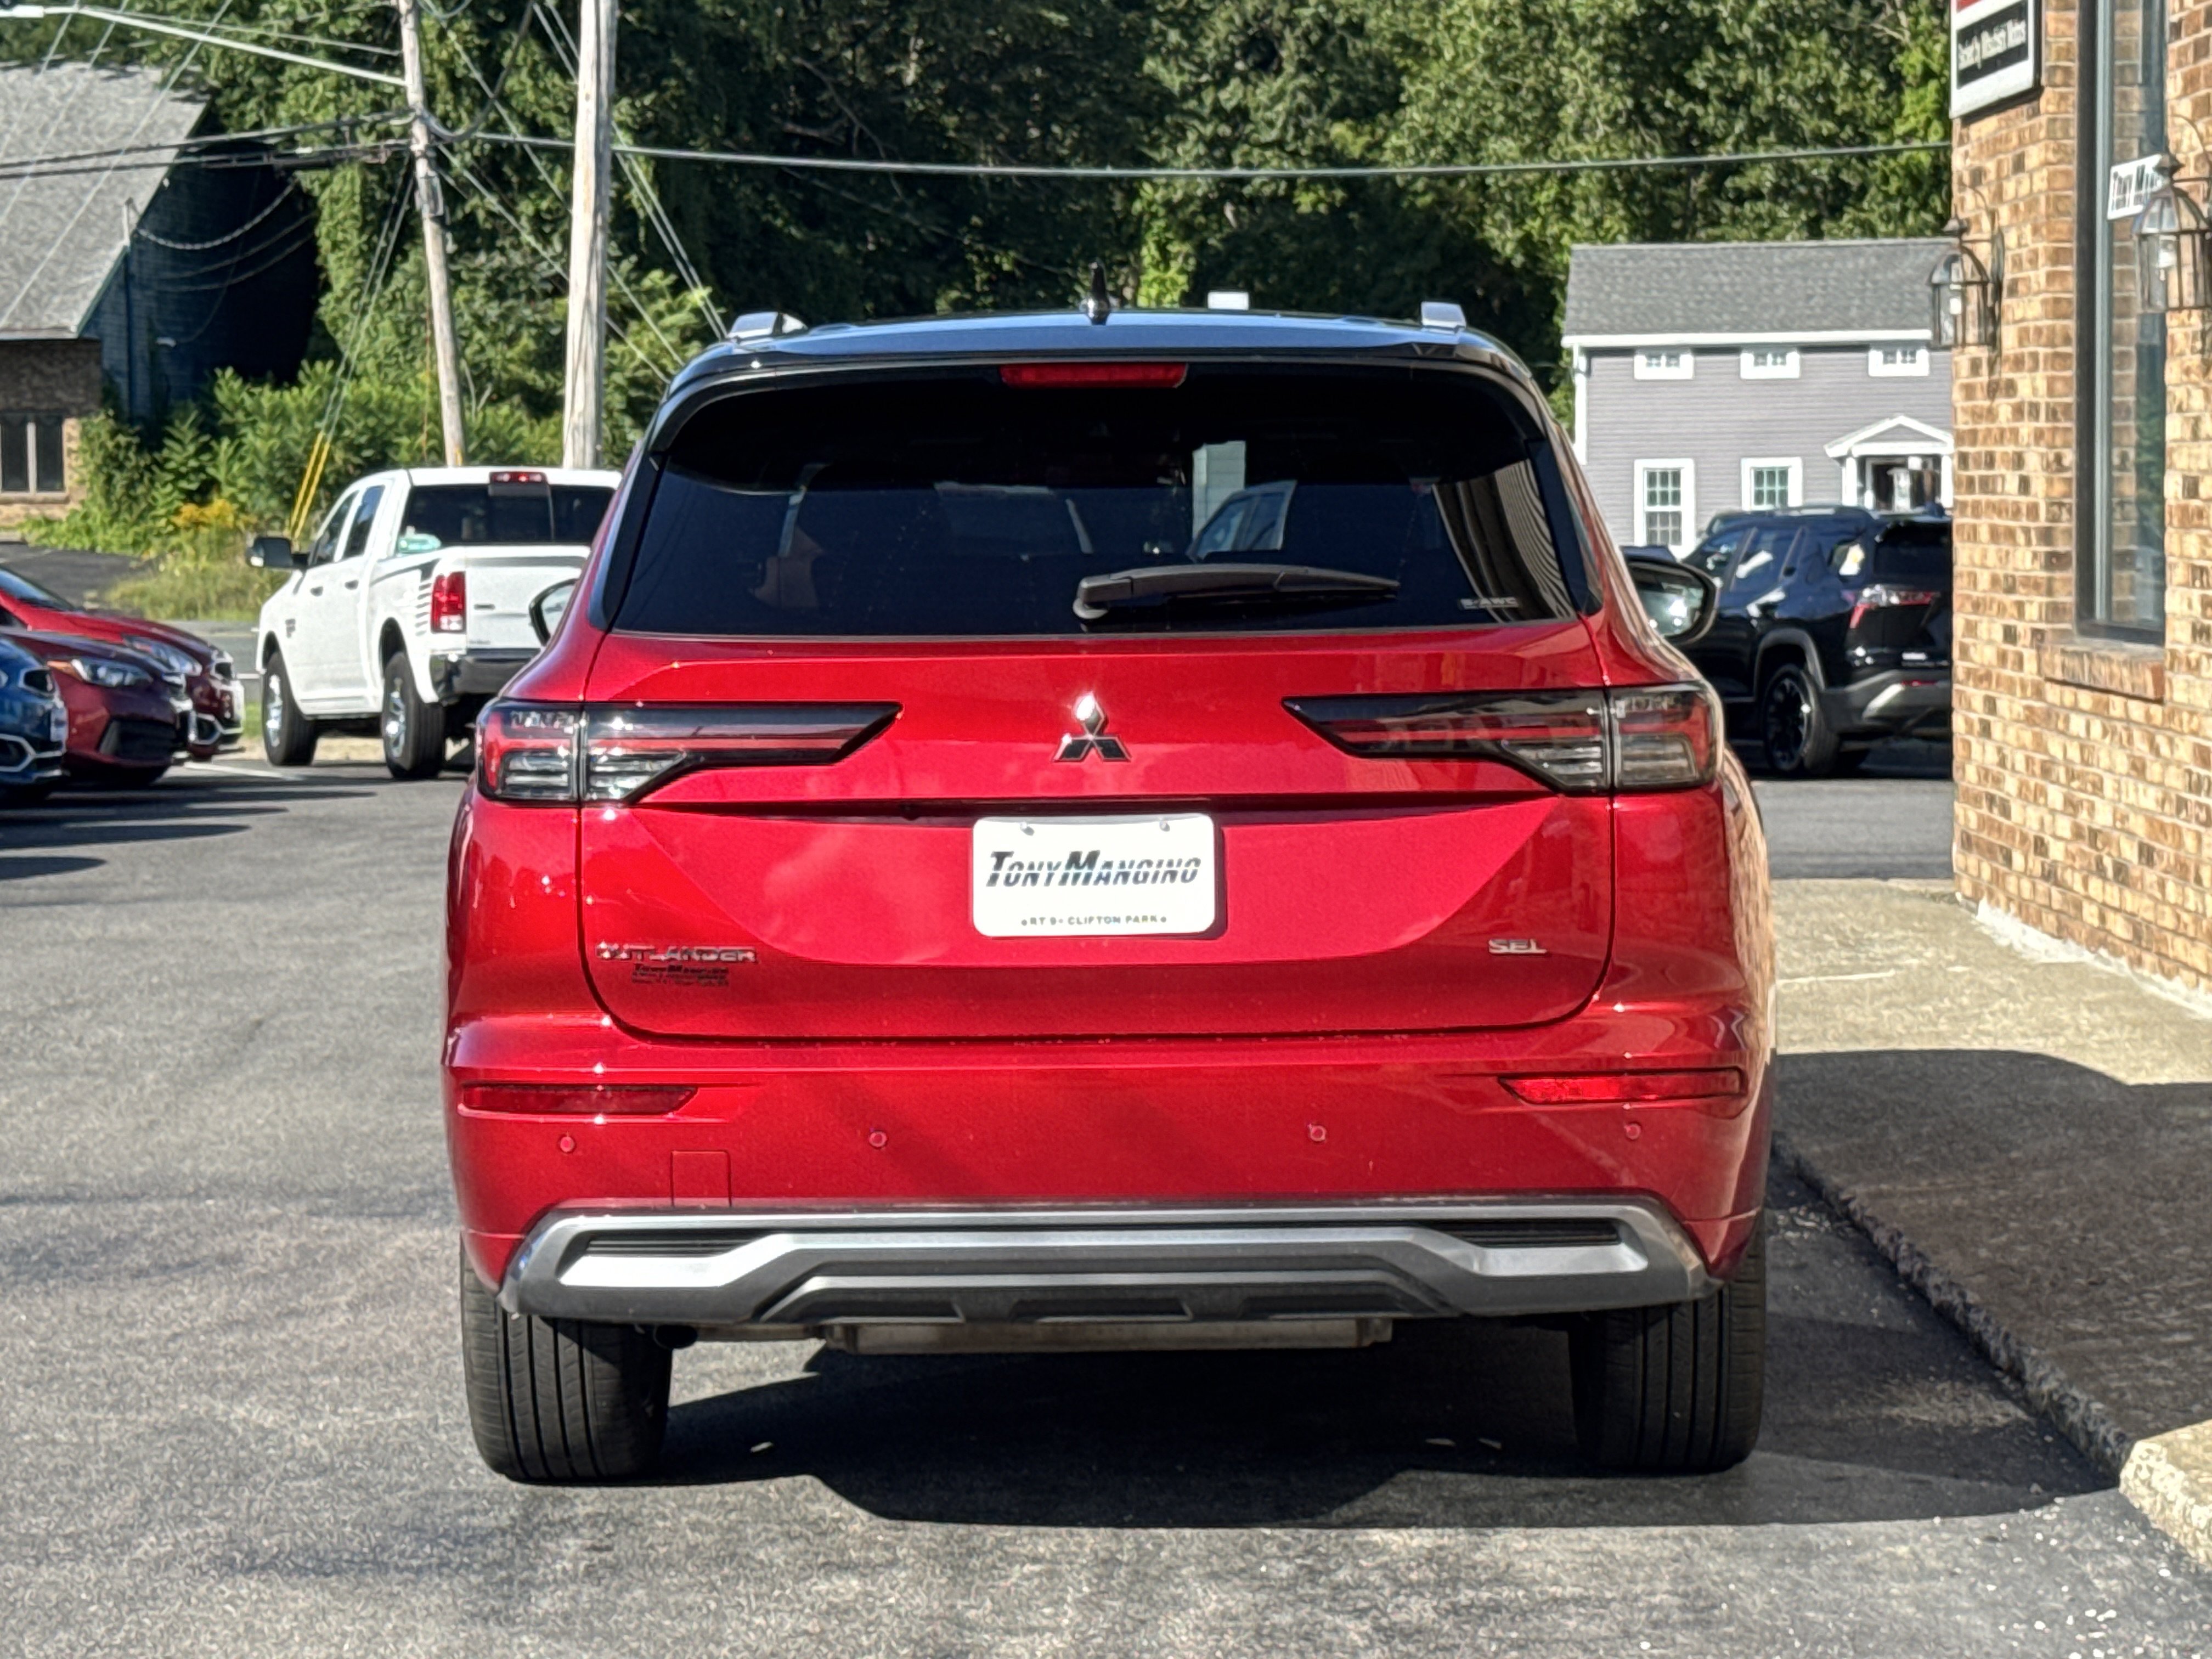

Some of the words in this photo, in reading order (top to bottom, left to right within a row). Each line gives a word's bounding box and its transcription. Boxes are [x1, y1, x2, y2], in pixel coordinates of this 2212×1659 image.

[1030, 917, 1046, 926] RT
[1068, 916, 1121, 926] CLIFTON
[1125, 915, 1158, 924] PARK
[1488, 938, 1548, 954] SEL
